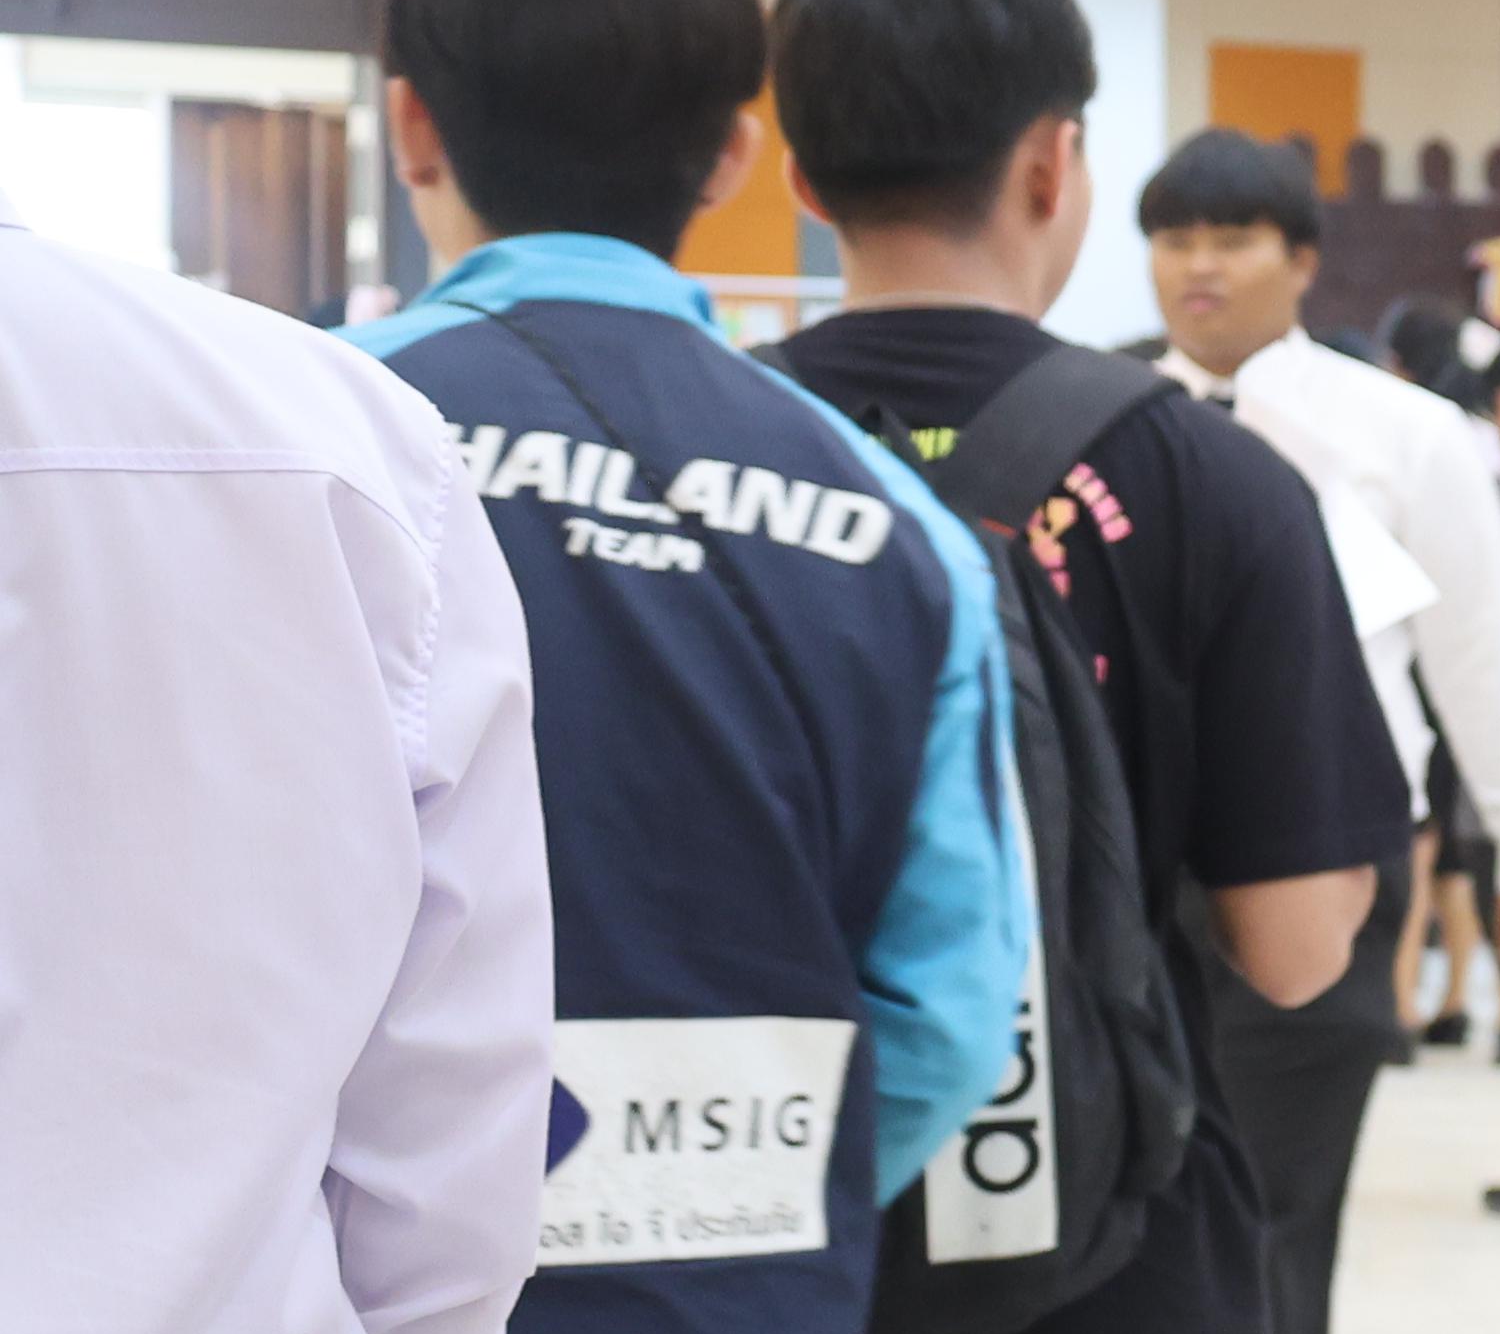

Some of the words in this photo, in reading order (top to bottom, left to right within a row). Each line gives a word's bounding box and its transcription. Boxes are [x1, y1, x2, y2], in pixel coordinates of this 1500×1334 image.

[444, 423, 894, 564] HAILAND
[562, 516, 706, 572] TEAM
[625, 1093, 812, 1154] MSIG
